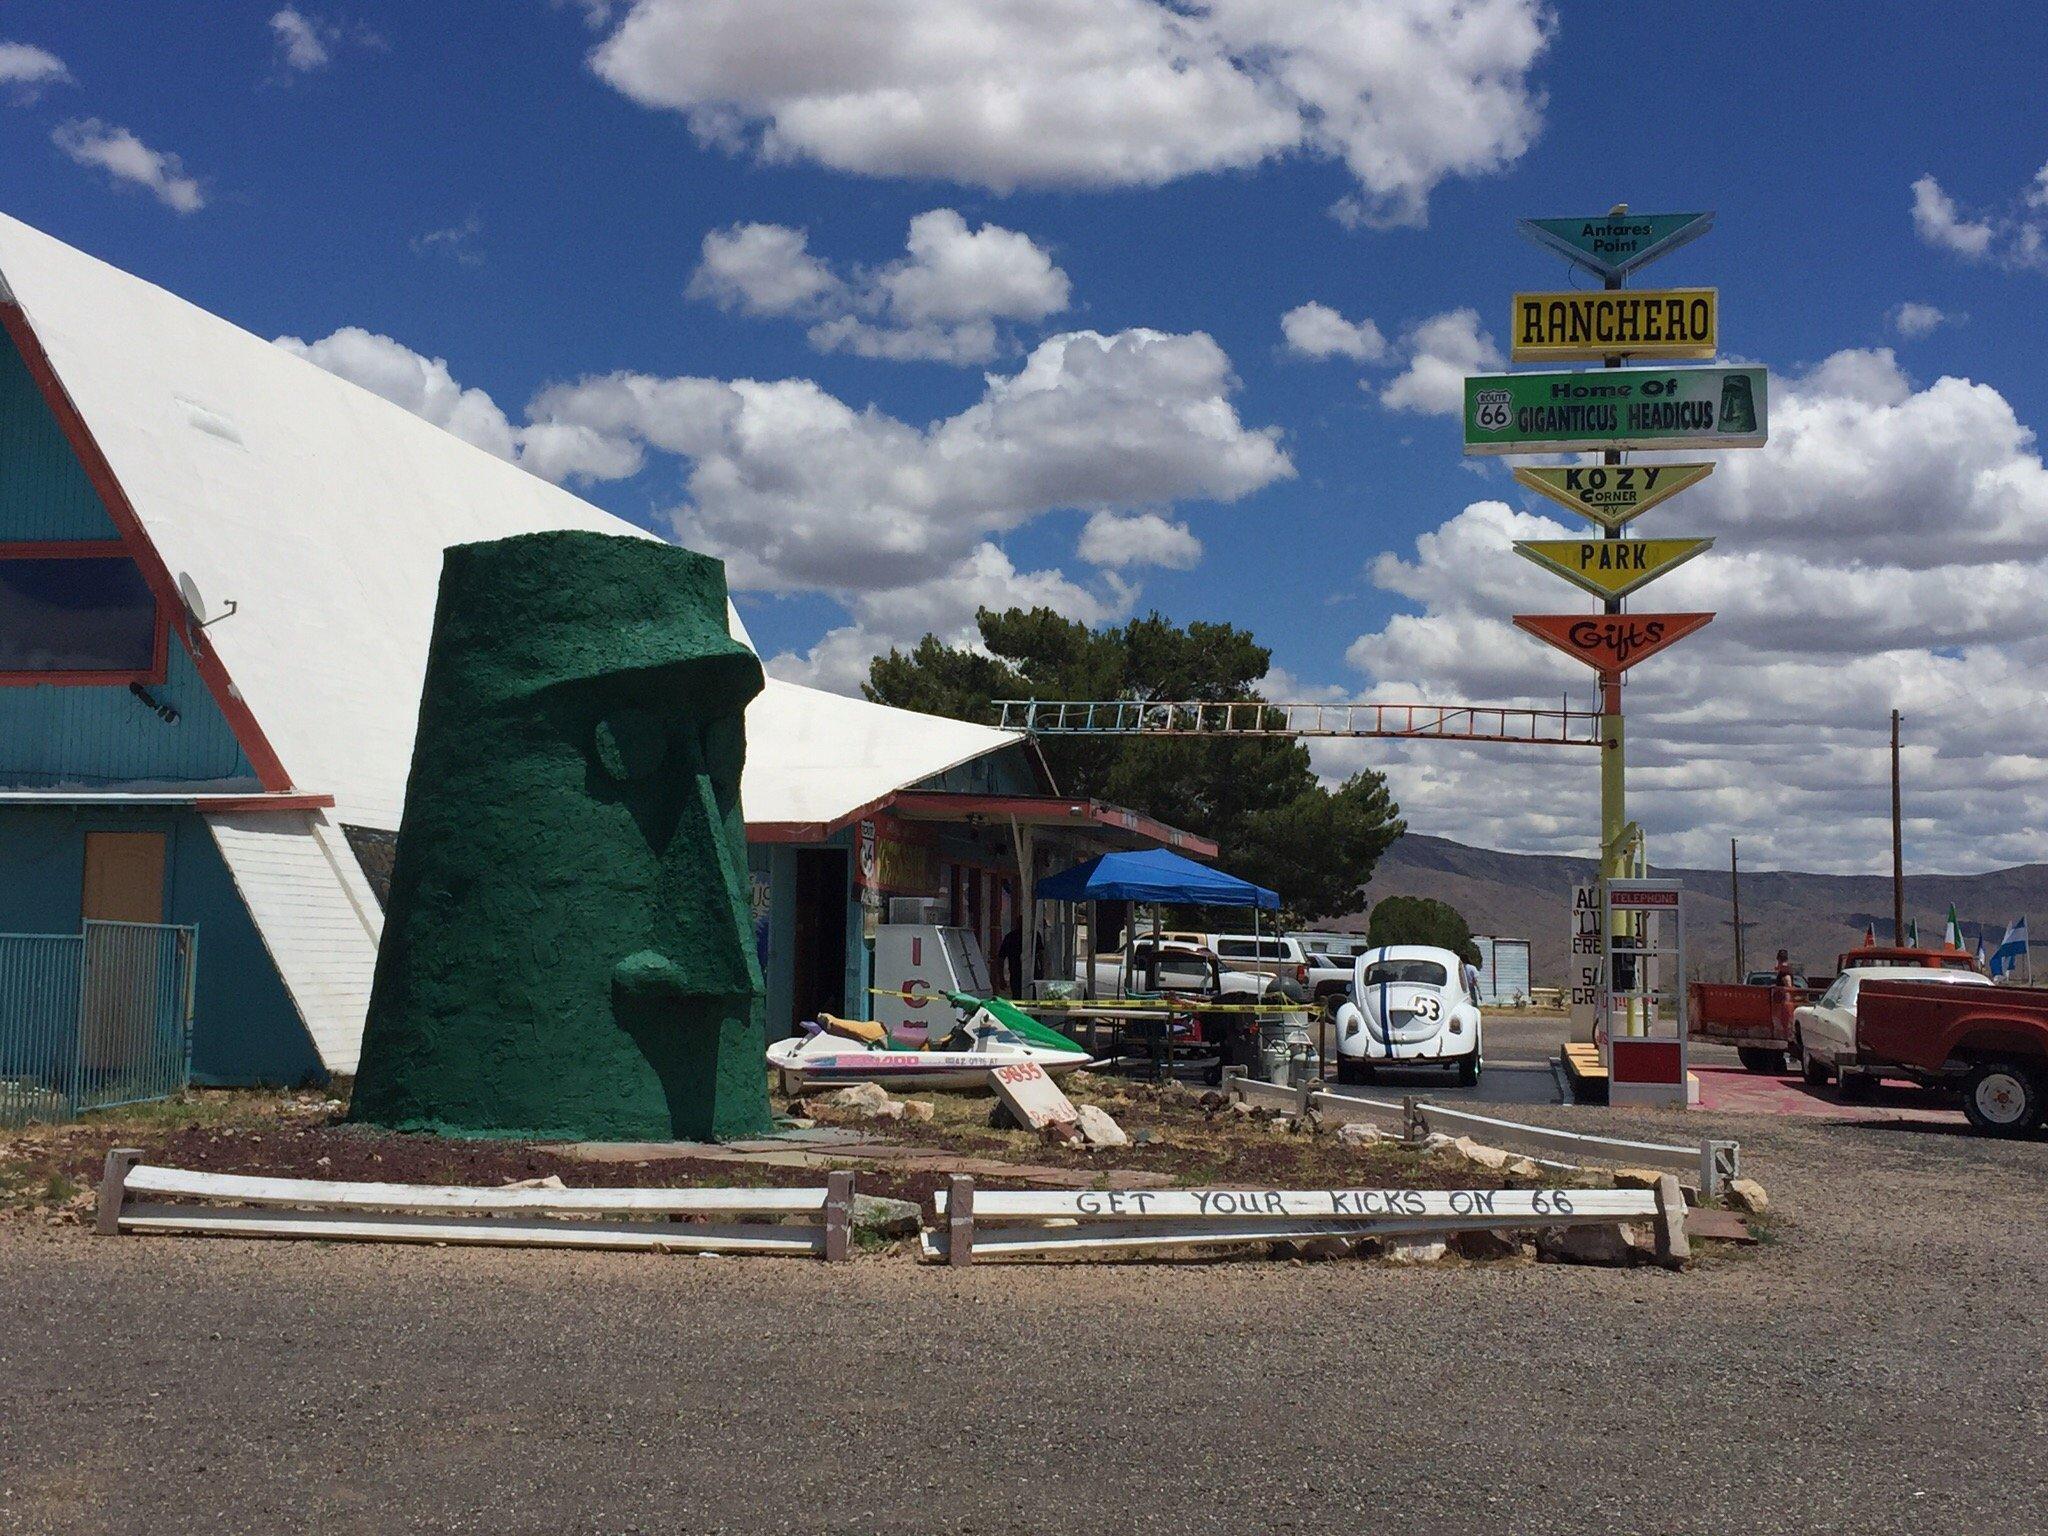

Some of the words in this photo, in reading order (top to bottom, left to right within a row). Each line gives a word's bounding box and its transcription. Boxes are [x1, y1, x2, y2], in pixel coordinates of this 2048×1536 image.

[1582, 223, 1651, 237] Antares
[1593, 239, 1637, 252] Point
[1523, 299, 1709, 343] RANCHERO
[1551, 383, 1632, 398] Home
[1640, 378, 1678, 397] Of
[1481, 404, 1508, 426] 66
[1517, 404, 1618, 433] GIGANTICUS
[1627, 400, 1714, 431] HEADICUS
[1566, 468, 1660, 490] KOZY
[1581, 544, 1647, 570] PARK
[1569, 622, 1665, 661] Gifts
[1615, 892, 1676, 904] TELEPHONE
[1414, 996, 1440, 1021] 53
[1076, 1191, 1155, 1215] GET
[1191, 1191, 1290, 1215] YOUR
[1329, 1190, 1427, 1215] KICKS
[1449, 1189, 1495, 1215] ON
[1531, 1190, 1573, 1215] 66
